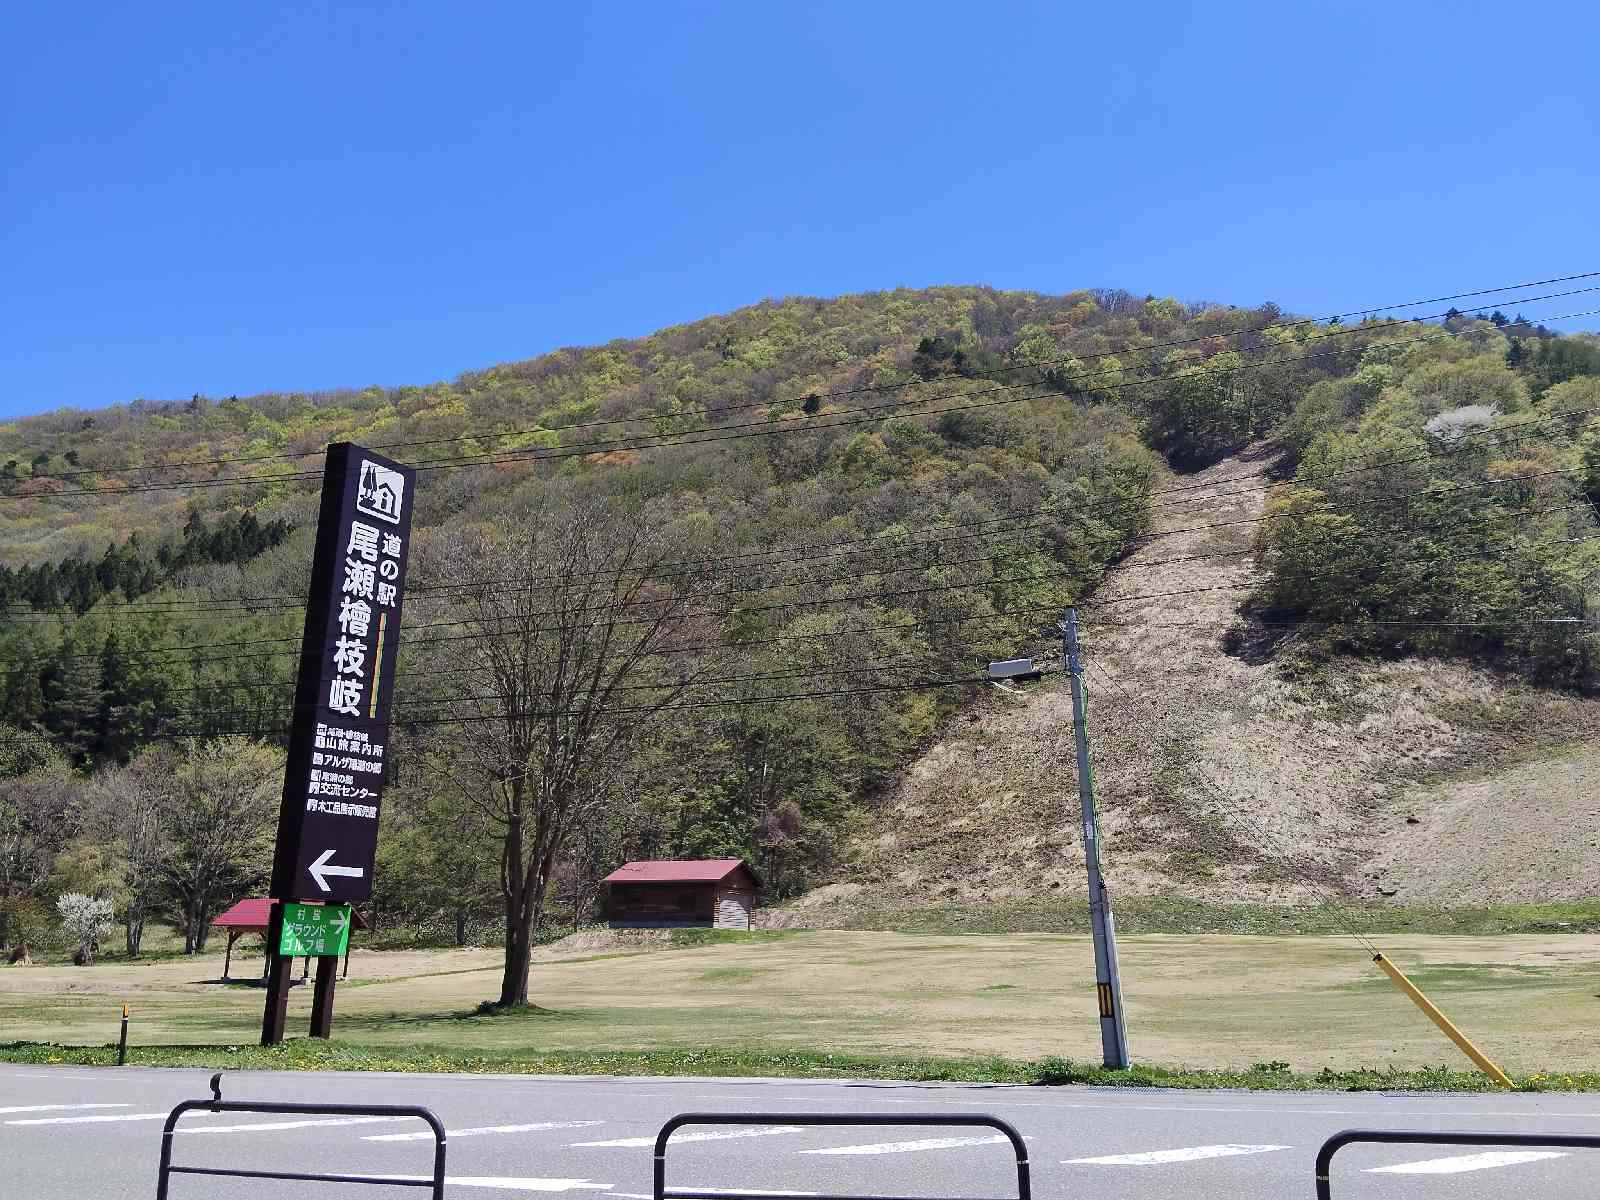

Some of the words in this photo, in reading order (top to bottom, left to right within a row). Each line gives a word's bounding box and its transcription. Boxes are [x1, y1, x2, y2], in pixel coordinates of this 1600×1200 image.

[376, 531, 402, 608] 道の駅
[328, 520, 380, 717] 尾瀬檜枝岐
[325, 737, 384, 758] 山旅案内所
[319, 782, 378, 798] 交流センター
[286, 922, 327, 936] グラウンド
[283, 938, 325, 953] ゴルフ場
